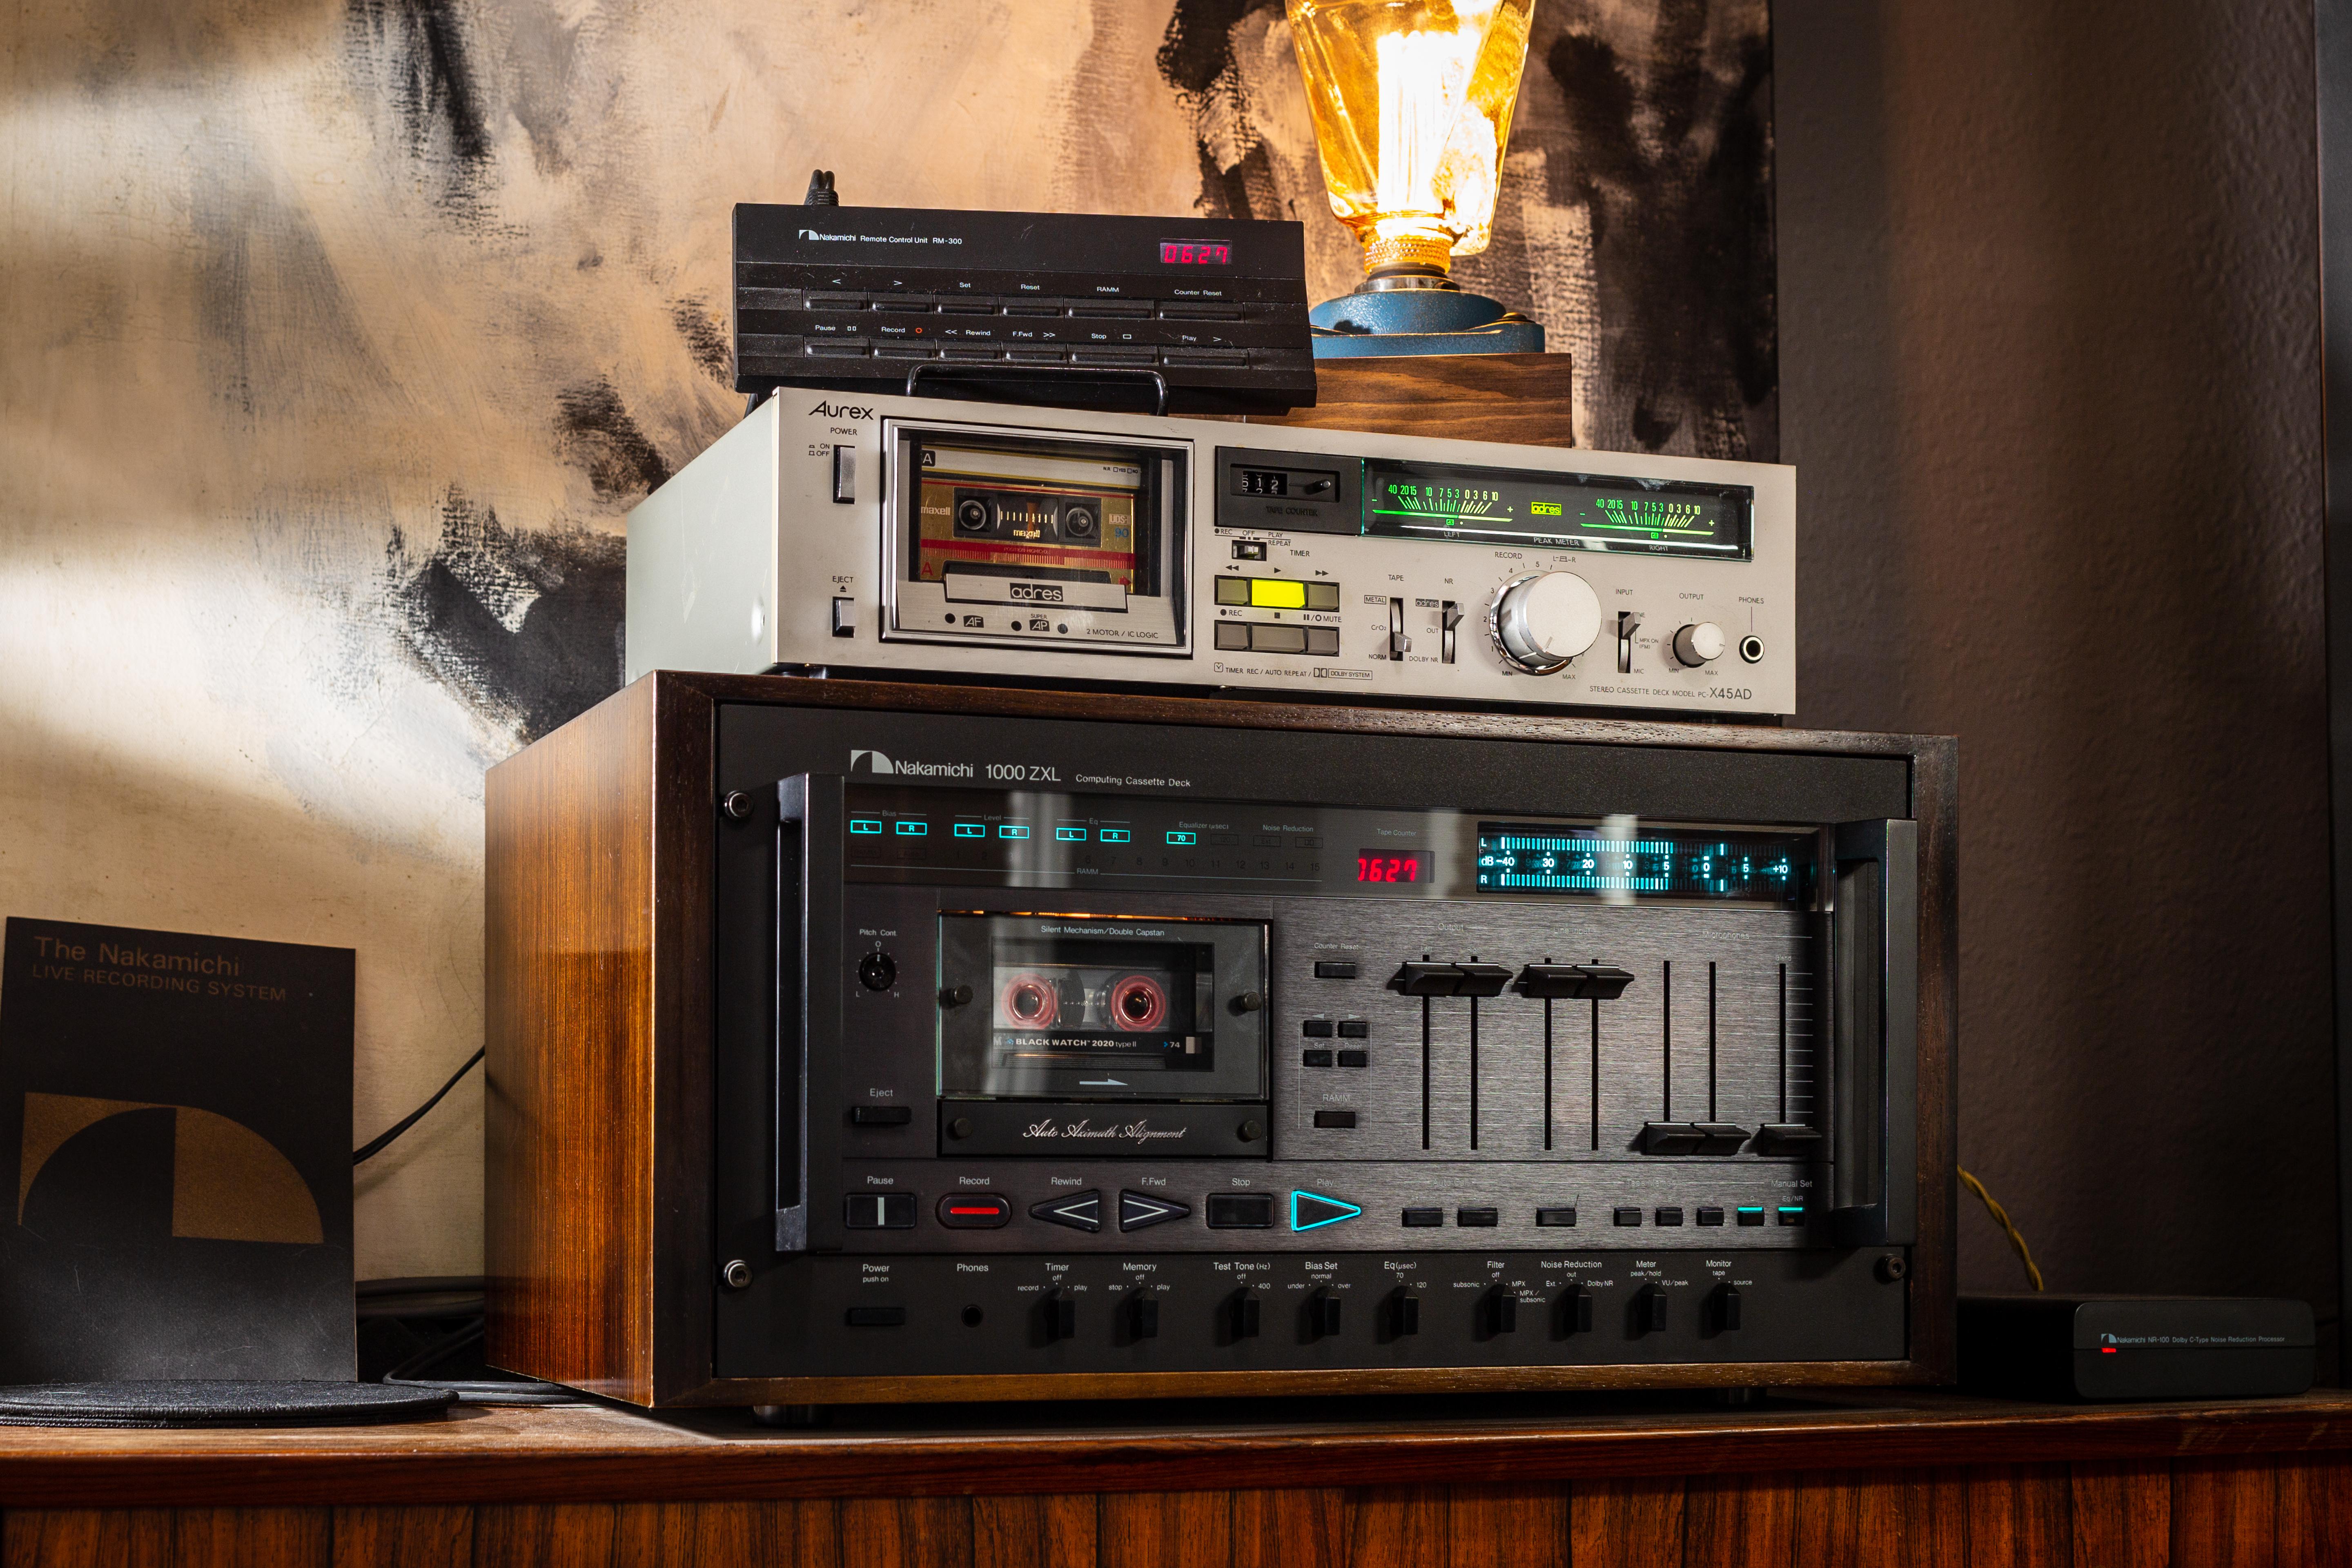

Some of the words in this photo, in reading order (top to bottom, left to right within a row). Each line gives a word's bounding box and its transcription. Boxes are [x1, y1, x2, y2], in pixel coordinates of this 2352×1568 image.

[819, 233, 856, 242] Nakamichi
[860, 235, 887, 243] Remote
[889, 236, 913, 244] Control
[1163, 245, 1228, 265] 0627
[808, 400, 874, 420] Aurex
[830, 427, 858, 435] POWER
[922, 453, 933, 464] A
[921, 506, 951, 516] maxell
[1286, 508, 1318, 517] COUNTER
[1013, 529, 1040, 538] maxell
[1494, 551, 1522, 559] RECORD
[921, 561, 934, 576] A
[832, 575, 854, 584] EJECT
[1011, 584, 1062, 601] adres
[1679, 592, 1704, 601] OUTPUT
[1416, 599, 1439, 607] adres
[895, 760, 974, 778] Nakamichi
[985, 764, 1025, 780] 1000
[1029, 766, 1061, 782] ZXL
[1076, 774, 1123, 786] Computing
[1125, 776, 1165, 786] Cassette
[1168, 778, 1191, 788] Deck
[1376, 828, 1392, 836] Tape
[1481, 856, 1494, 866] dB
[1041, 925, 1061, 933] Silent
[1064, 926, 1134, 935] Mechanism/Double
[1136, 929, 1165, 937] Capstan
[34, 935, 86, 962] The
[99, 942, 240, 977] Nakamichi
[33, 963, 74, 981] LIVE
[83, 969, 199, 994] RECORDING
[207, 981, 286, 1002] SYSTEM
[1115, 1040, 1131, 1049] type
[870, 1088, 893, 1098] Eject
[1022, 1118, 1058, 1138] Auto
[1061, 1118, 1119, 1138] Azimuth
[1118, 1119, 1187, 1145] Alignment
[867, 1176, 894, 1185] Pause
[959, 1176, 990, 1185] Record
[1051, 1177, 1082, 1185] Rewind
[1142, 1177, 1166, 1185] F.Fwd
[1232, 1178, 1251, 1187] Stop
[1316, 1178, 1334, 1187] Play
[1771, 1180, 1798, 1188] Manual
[1800, 1180, 1813, 1188] Set
[862, 1264, 890, 1272] Power
[957, 1263, 989, 1272] Phones
[1045, 1263, 1069, 1271] Timer
[1123, 1263, 1157, 1272] Memory
[1213, 1262, 1231, 1270] Test
[1234, 1262, 1254, 1270] Tone
[1256, 1262, 1270, 1270] (Hz)
[1305, 1262, 1323, 1270] Bias
[1324, 1262, 1338, 1270] Set
